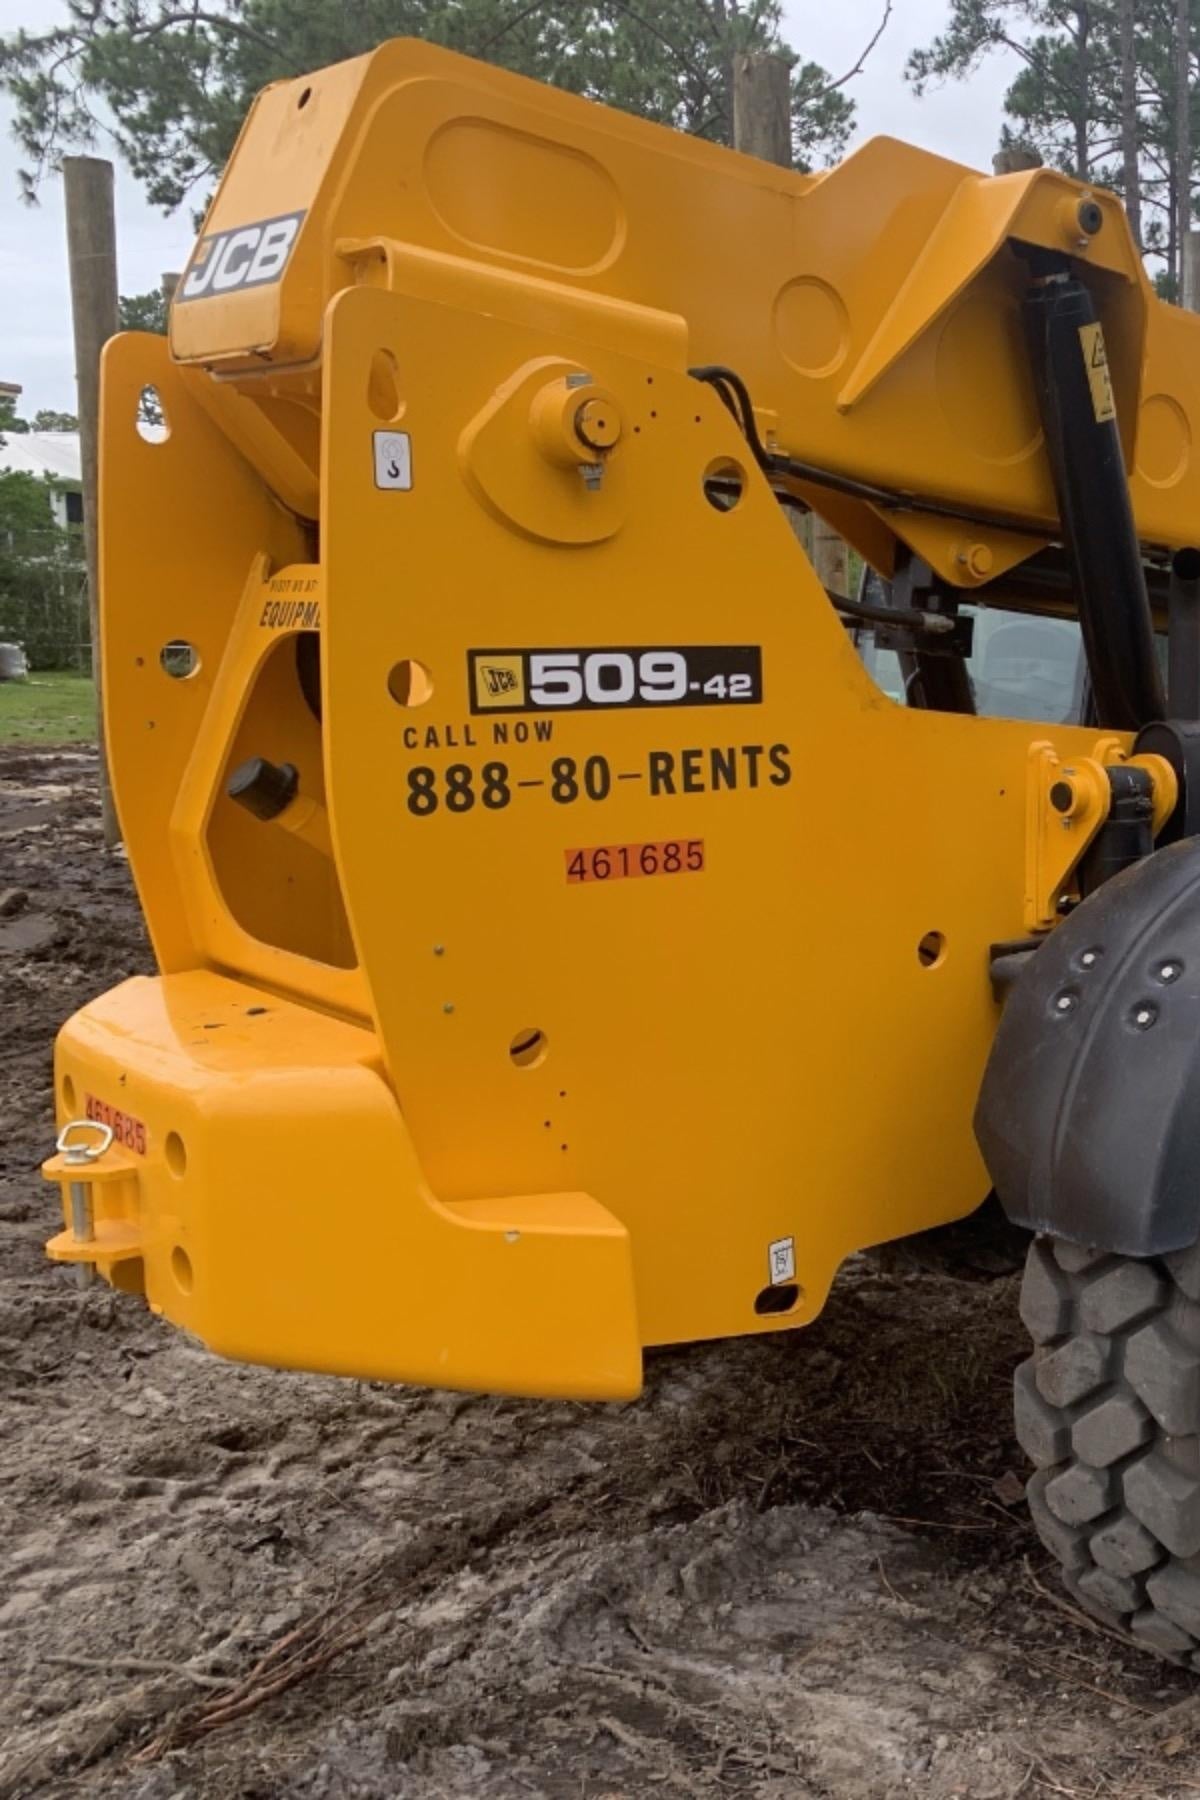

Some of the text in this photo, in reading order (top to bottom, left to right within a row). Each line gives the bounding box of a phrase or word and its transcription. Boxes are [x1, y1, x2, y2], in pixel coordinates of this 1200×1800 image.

[183, 217, 299, 296] JCB
[529, 651, 753, 705] 509-42
[403, 720, 554, 748] CALL NOW
[406, 743, 792, 817] 888-80-RENTS
[566, 840, 704, 881] 461685
[86, 1096, 146, 1155] 461685
